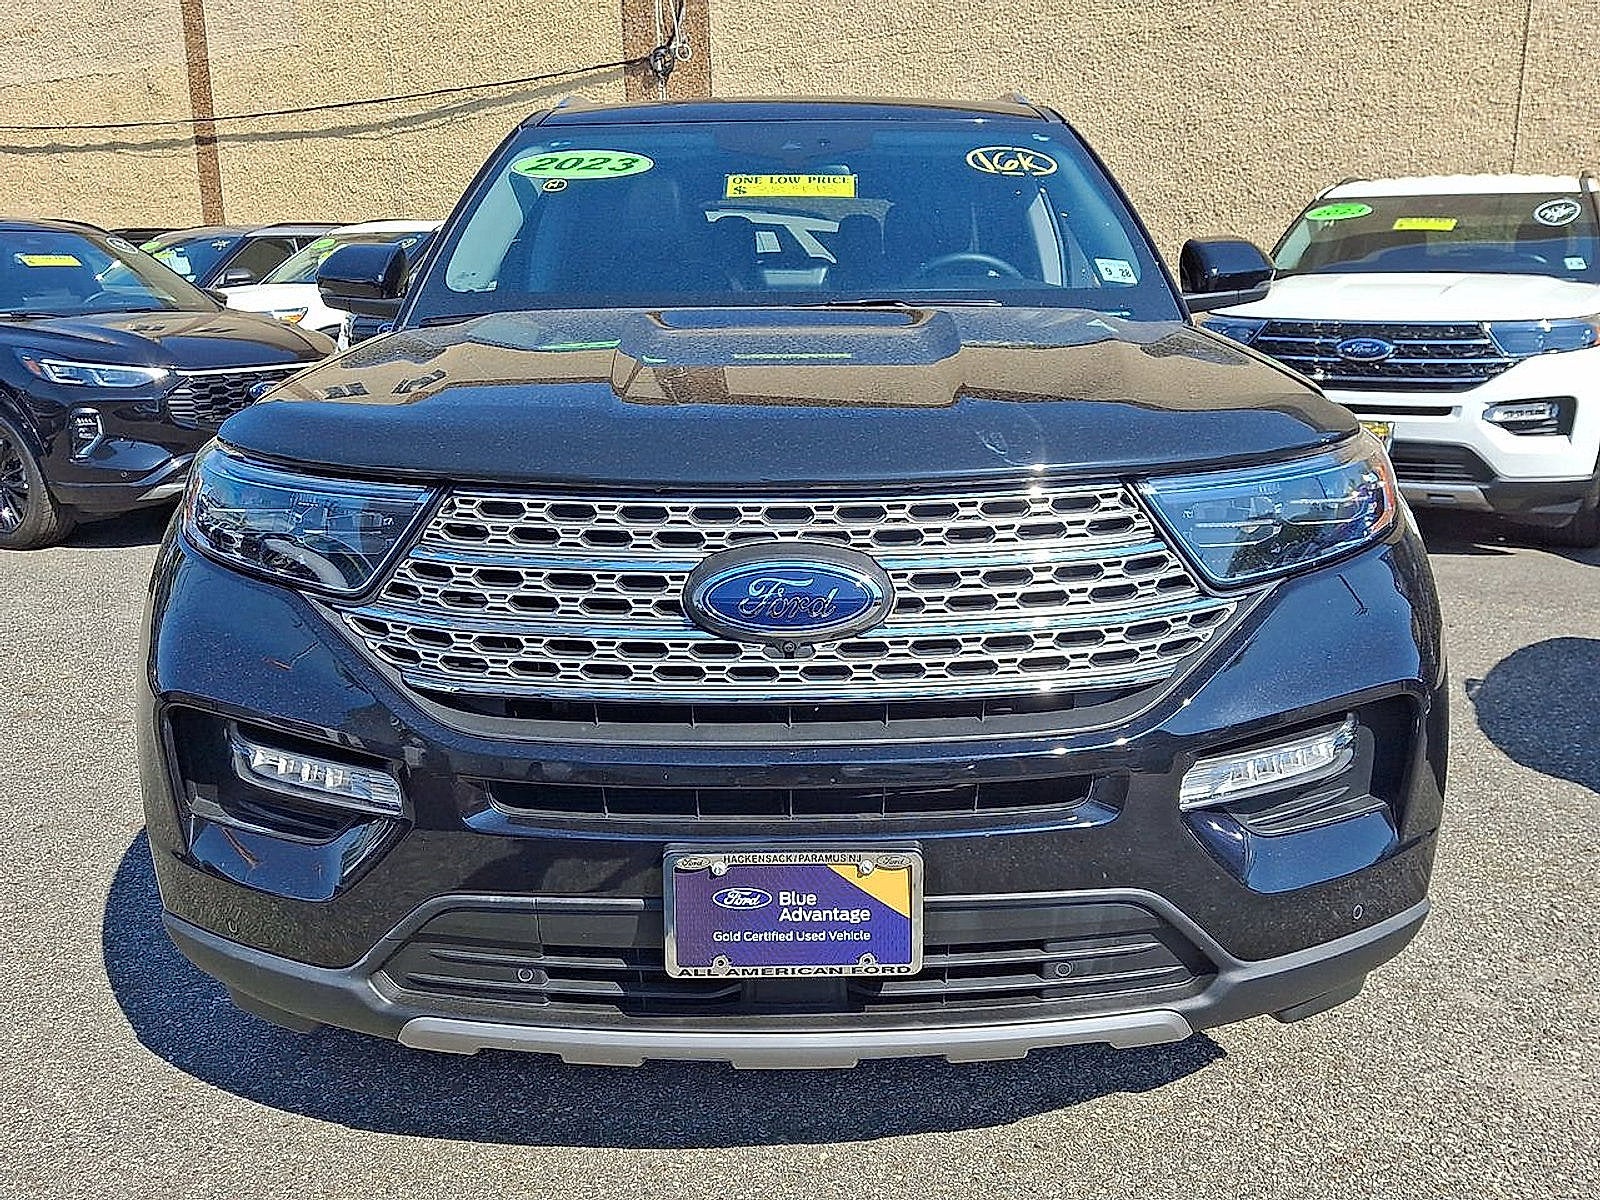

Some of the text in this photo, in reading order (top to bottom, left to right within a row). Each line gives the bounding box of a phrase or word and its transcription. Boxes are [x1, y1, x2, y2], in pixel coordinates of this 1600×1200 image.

[524, 157, 640, 172] 2023
[732, 176, 850, 184] ONE LOW PRICE
[738, 577, 839, 619] Ford
[723, 891, 763, 906] Ford
[779, 892, 817, 906] Blue
[779, 908, 871, 924] Advantage
[713, 931, 871, 942] Gold Certified Used Vehicle
[677, 966, 911, 976] ALL AMERICAN FORD
